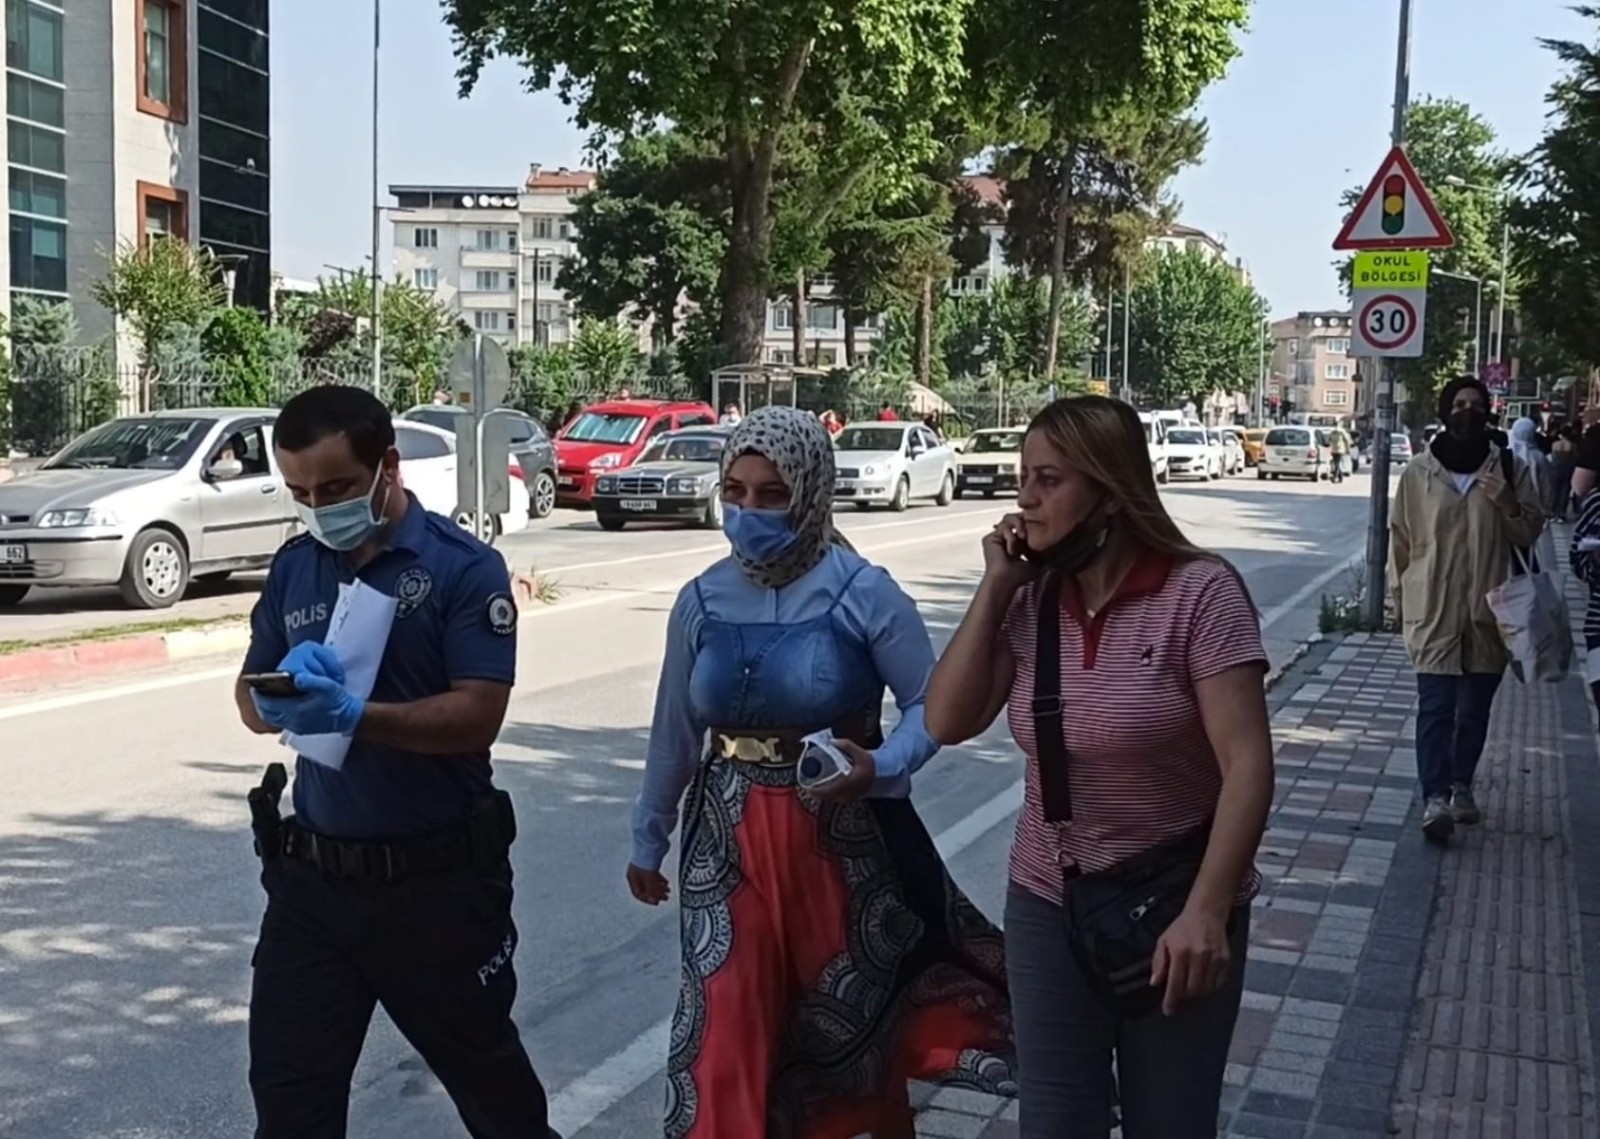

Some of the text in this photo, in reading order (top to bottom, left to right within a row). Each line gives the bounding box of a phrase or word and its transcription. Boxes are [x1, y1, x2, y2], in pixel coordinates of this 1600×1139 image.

[1373, 255, 1411, 266] OKUL
[1360, 268, 1421, 282] BÖLGESİ
[1369, 309, 1406, 334] 30
